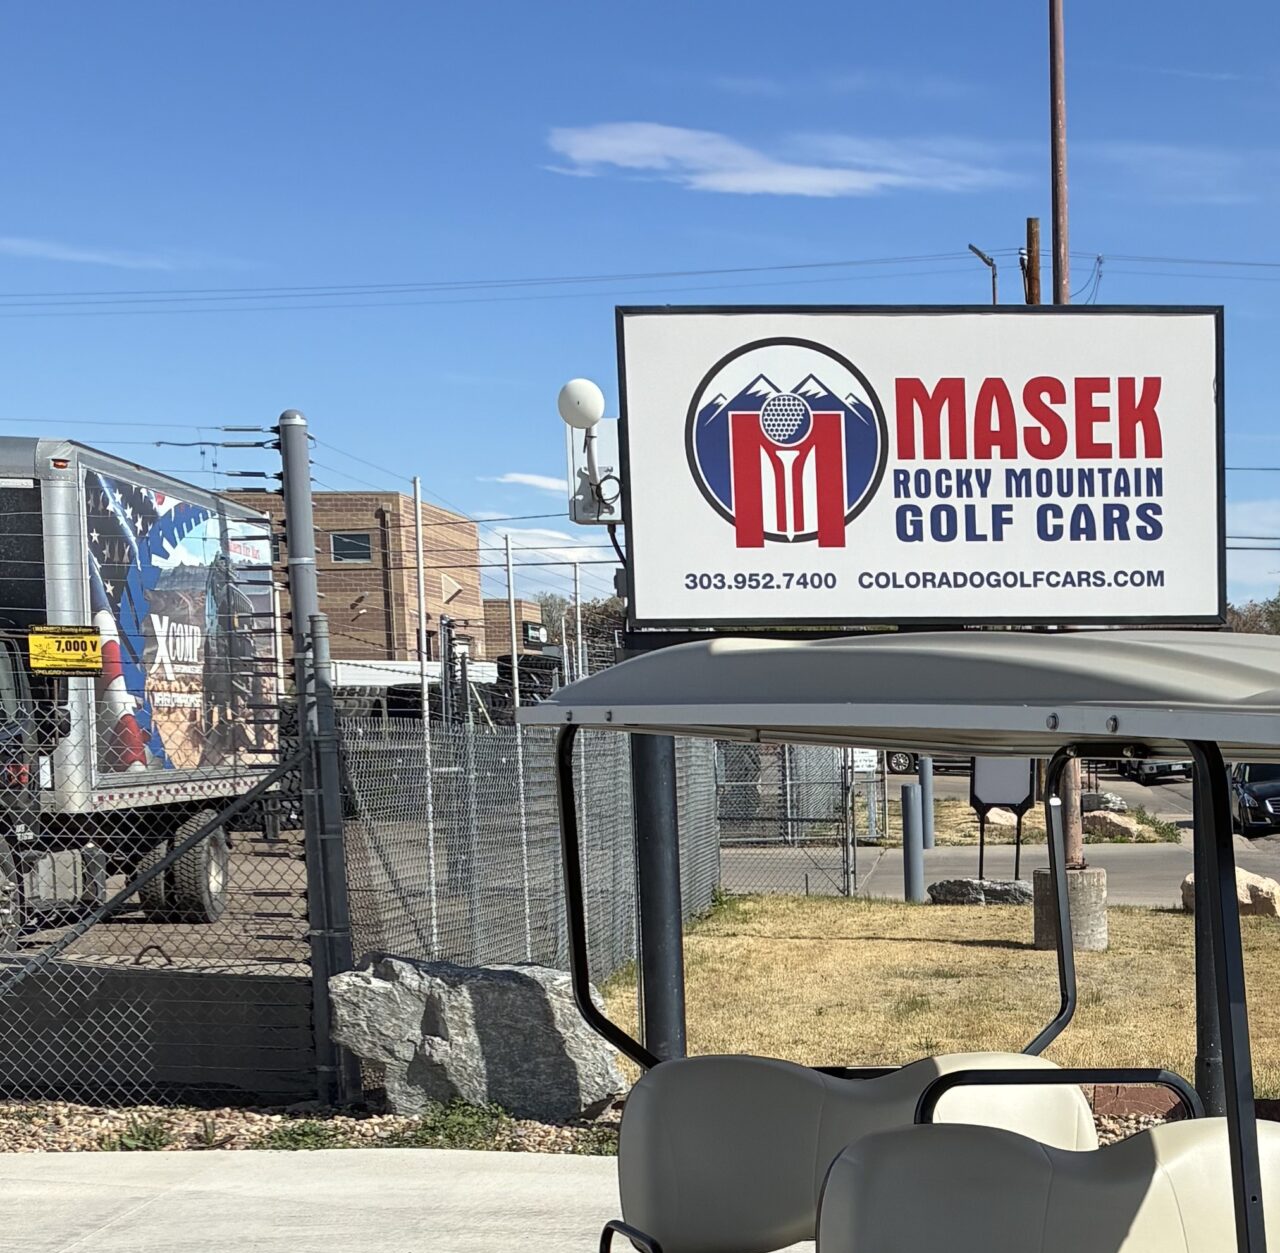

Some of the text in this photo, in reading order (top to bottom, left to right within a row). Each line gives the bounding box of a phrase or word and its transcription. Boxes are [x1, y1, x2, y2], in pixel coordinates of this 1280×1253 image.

[895, 376, 1163, 460] MASEK
[893, 467, 1163, 499] ROCKY MOUNTAIN
[895, 502, 1163, 543] GOLF CARS
[684, 570, 1165, 590] 303.952.7400 COLORADOGOLFCARS.COM
[55, 640, 98, 653] 7,000 V
